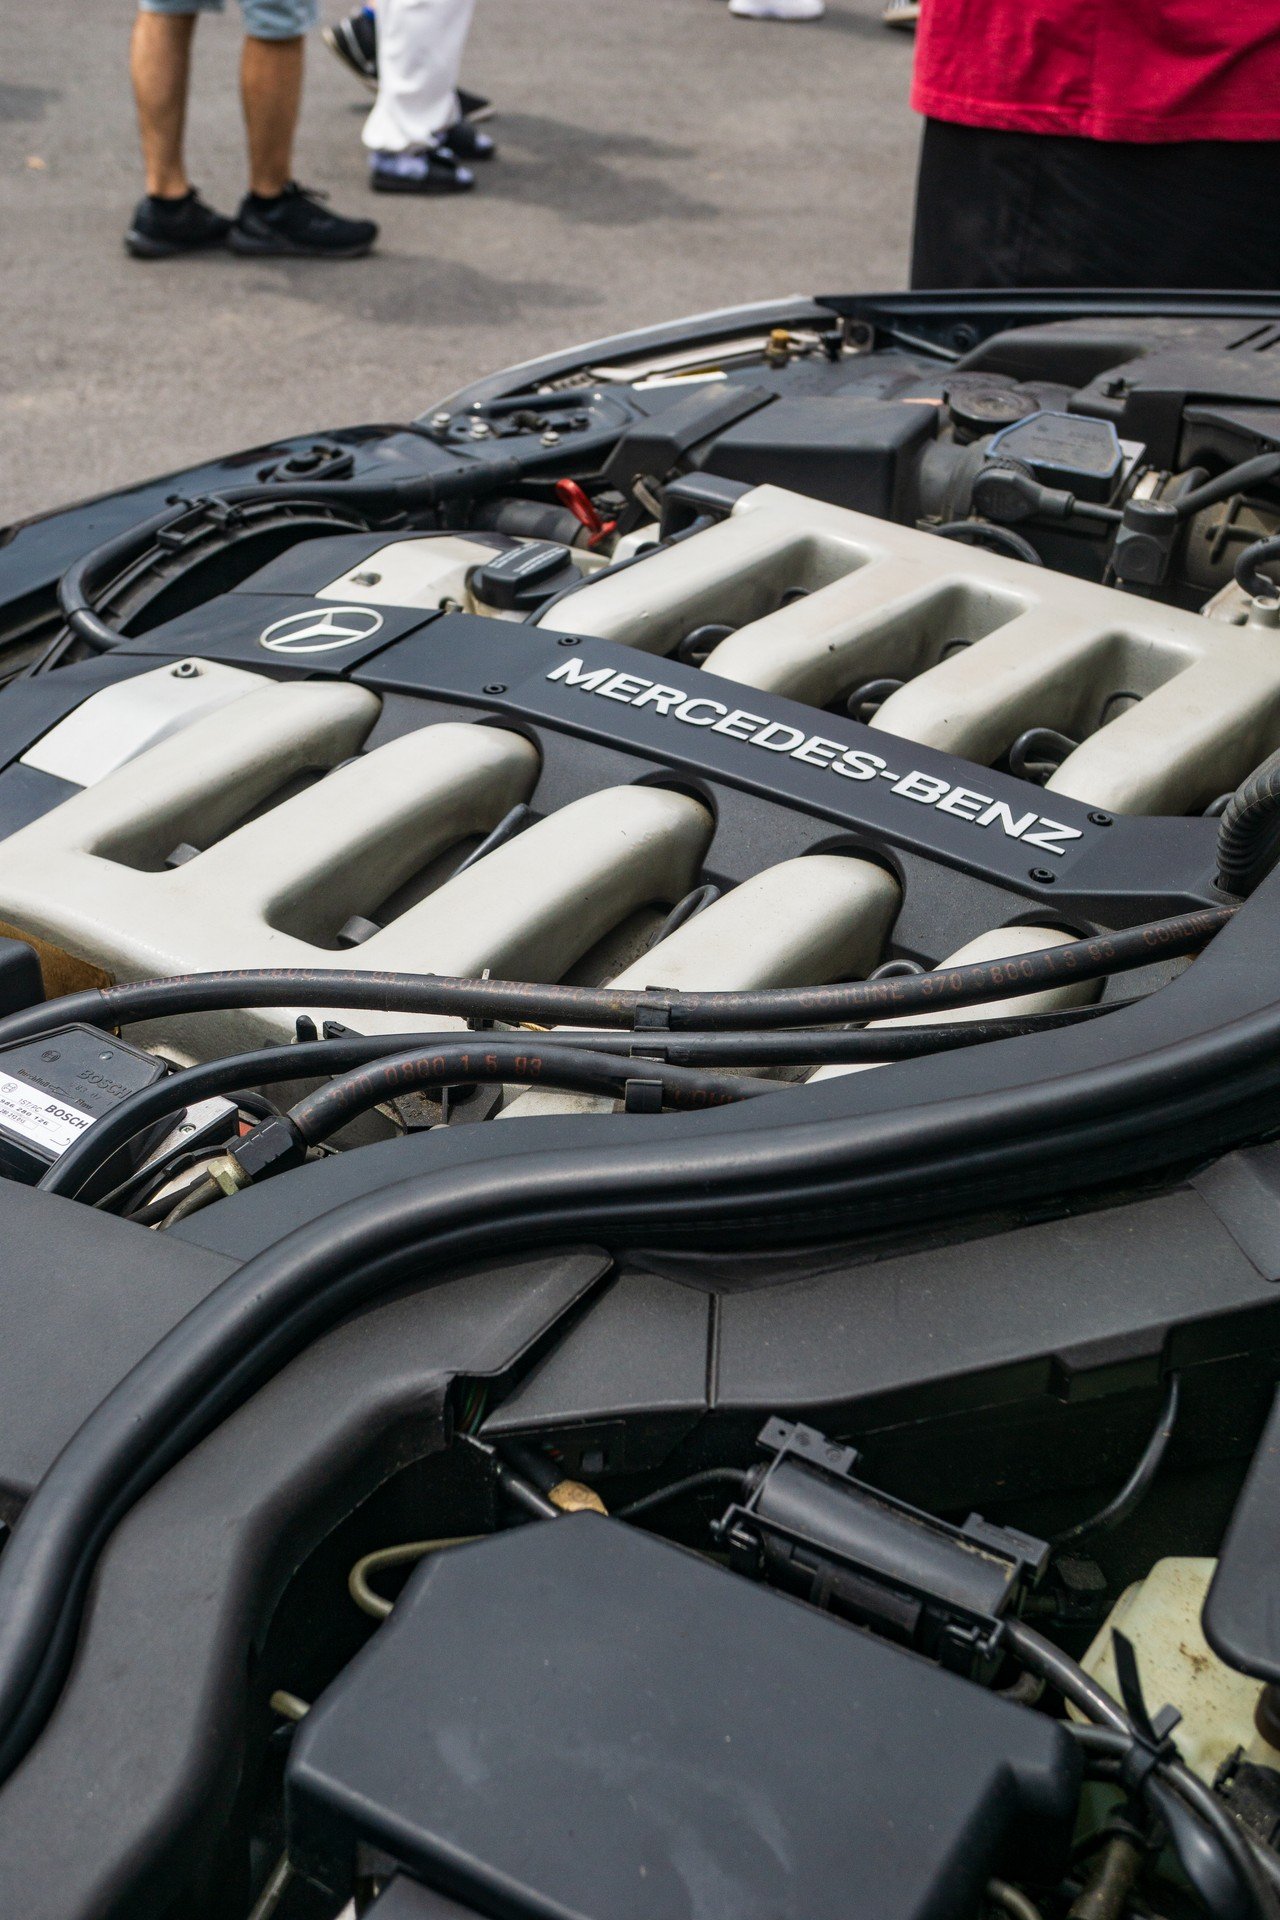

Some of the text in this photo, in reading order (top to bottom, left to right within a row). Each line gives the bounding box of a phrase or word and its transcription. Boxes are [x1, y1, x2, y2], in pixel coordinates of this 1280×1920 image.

[546, 657, 1083, 856] MERCEDES-BENZ
[798, 980, 906, 1009] COHLINE
[921, 974, 963, 997] 370
[1044, 953, 1056, 974] 1
[1062, 949, 1079, 969] 3
[1087, 939, 1117, 962] 93
[1142, 914, 1214, 947] COHLINE
[443, 976, 537, 996] COHLINE
[76, 1069, 133, 1100] BOSCH
[331, 1074, 374, 1107] 370
[383, 1056, 446, 1085] 0800
[461, 1055, 470, 1072] 1
[16, 1106, 32, 1117] 280
[34, 1115, 49, 1126] 126
[45, 1104, 89, 1130] BOSCH
